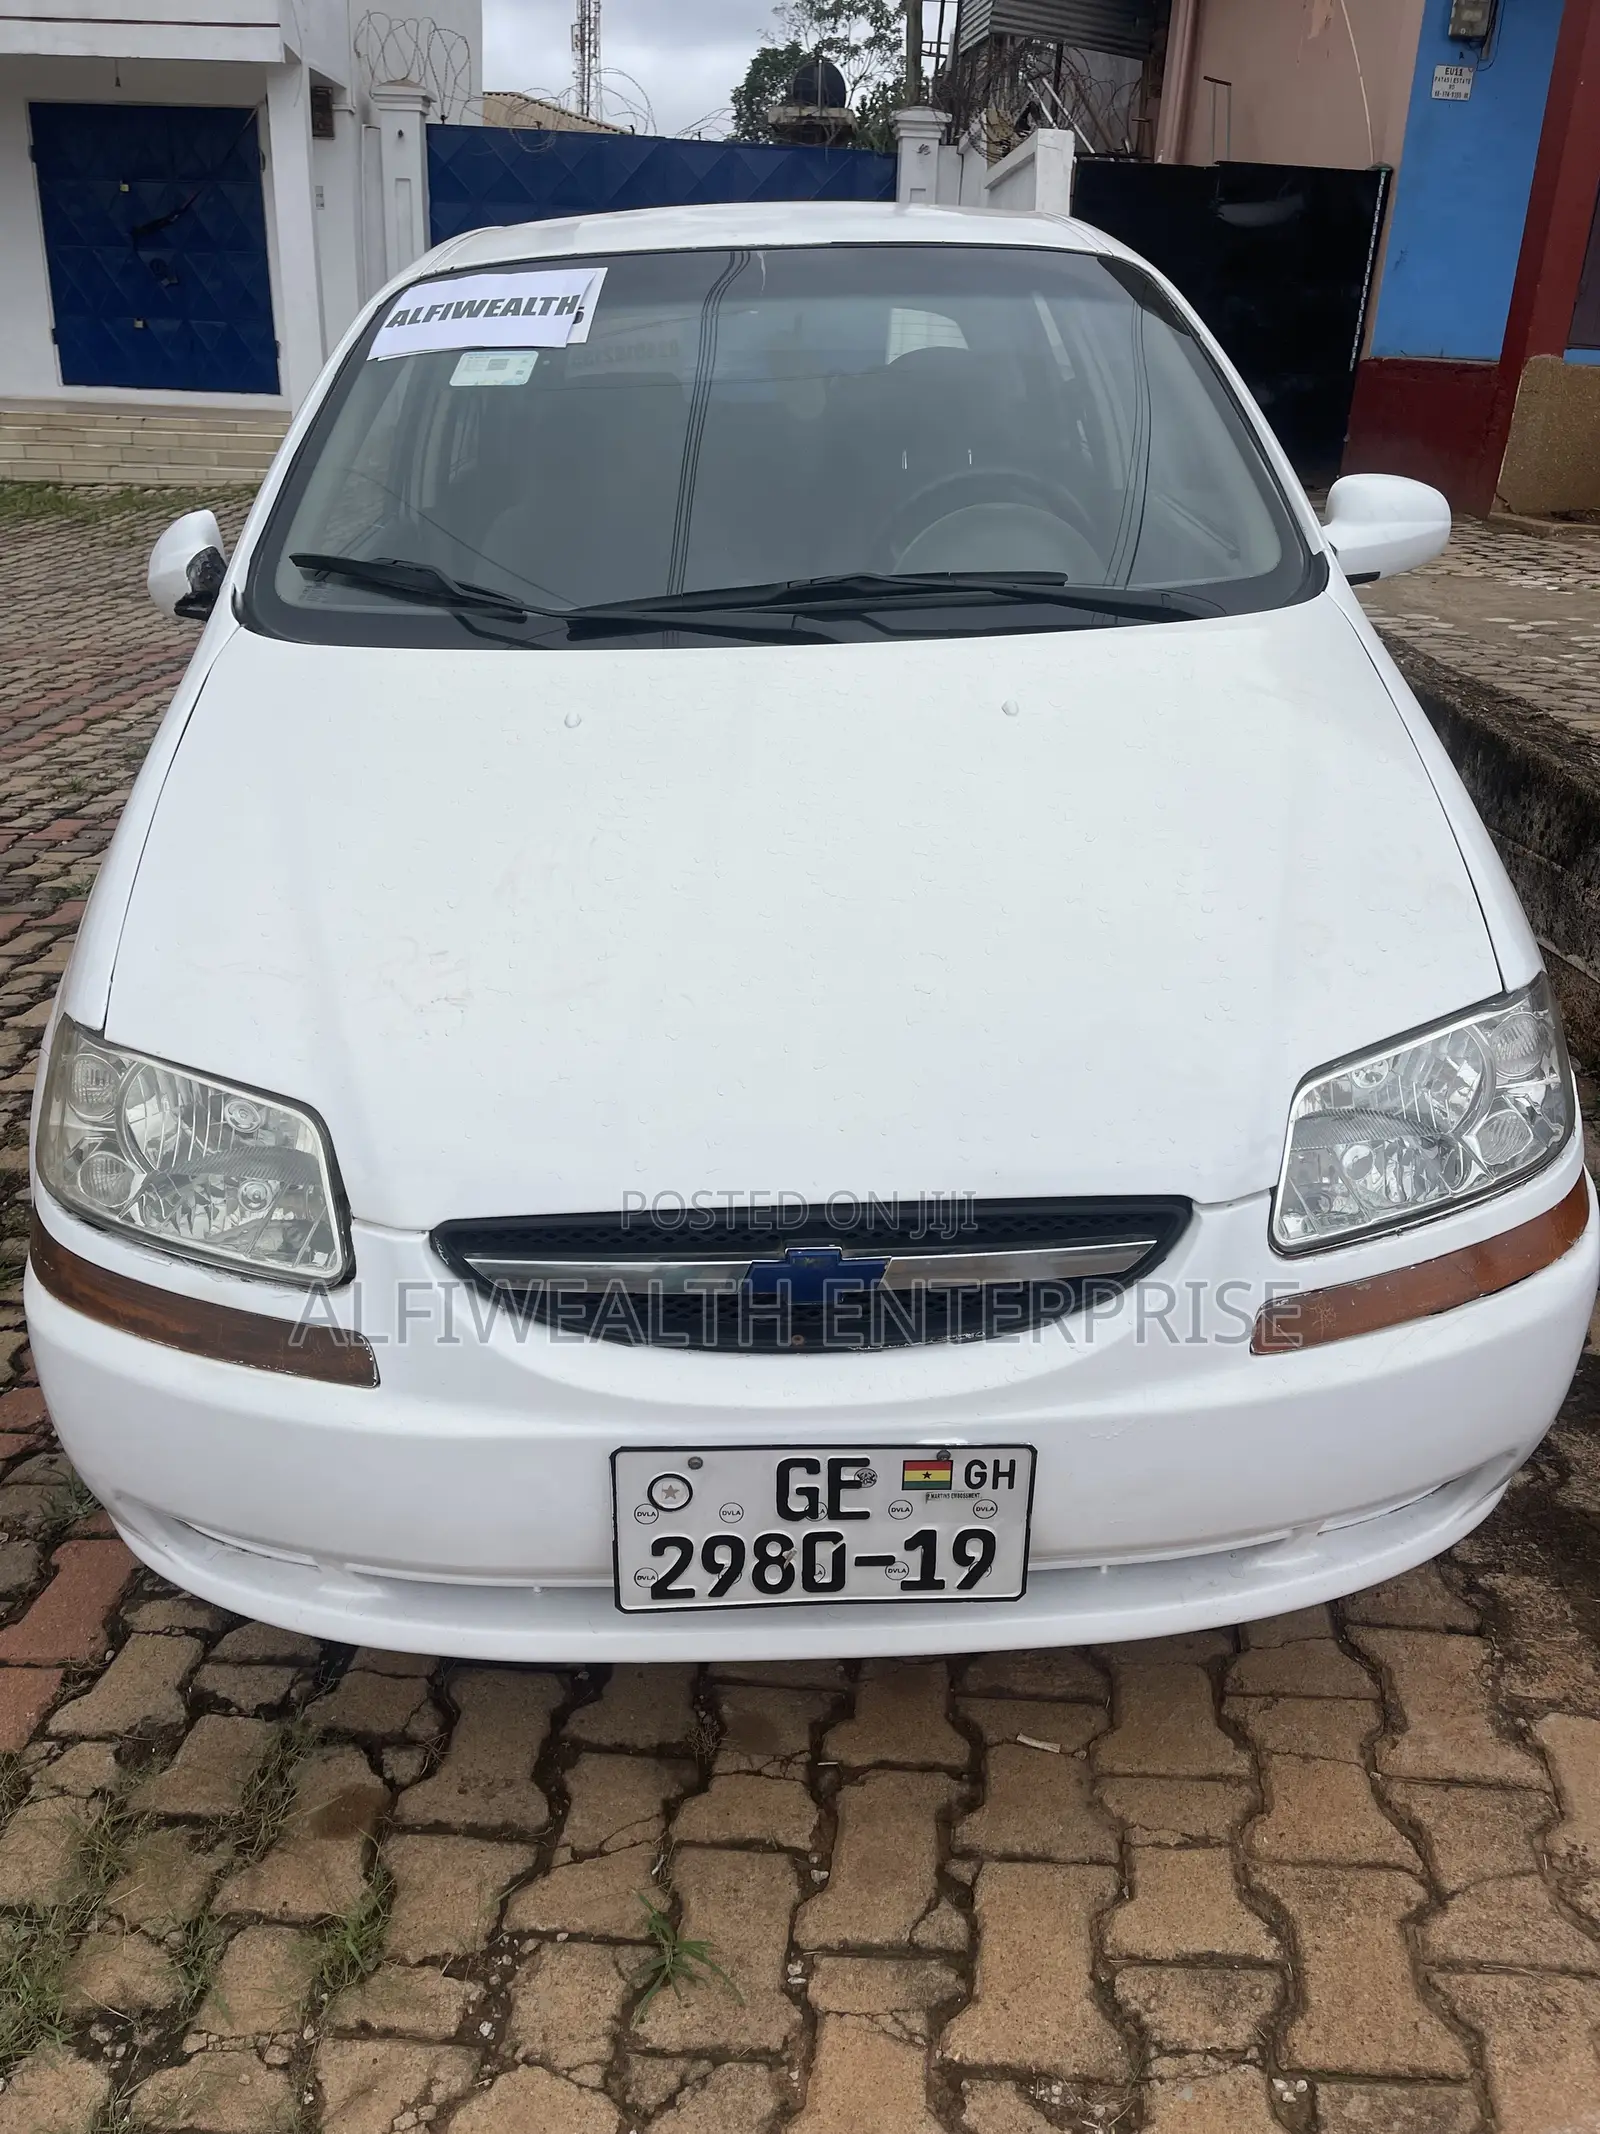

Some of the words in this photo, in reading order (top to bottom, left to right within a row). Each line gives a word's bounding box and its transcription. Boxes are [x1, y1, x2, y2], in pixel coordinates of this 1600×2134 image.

[385, 294, 581, 328] ALFIWEALTH
[776, 1457, 870, 1521] GE
[964, 1459, 1016, 1490] GH
[651, 1528, 997, 1600] 2980-19
